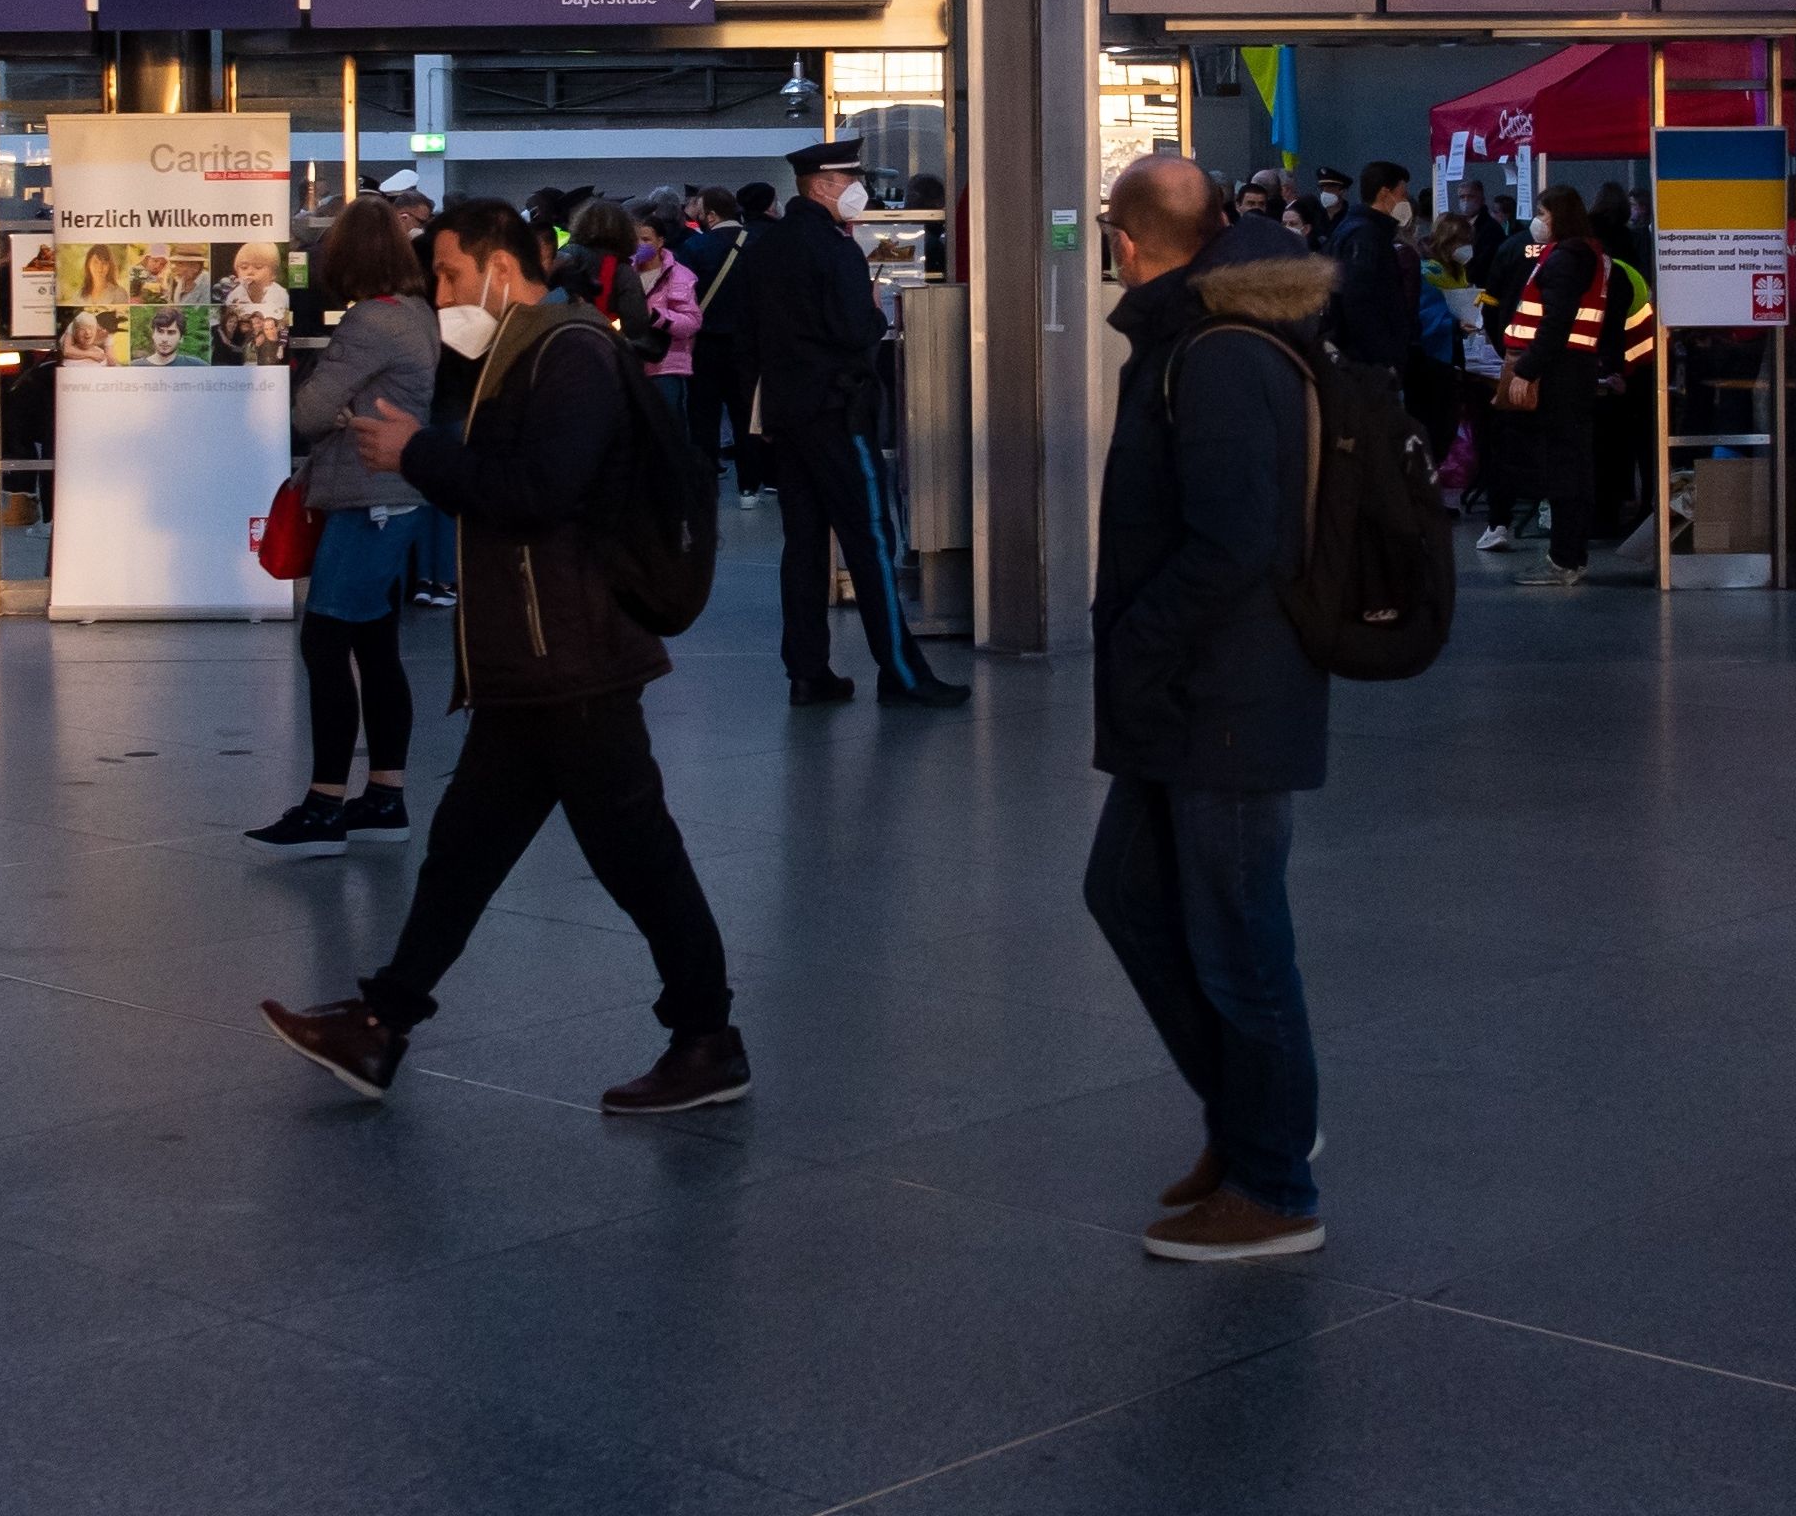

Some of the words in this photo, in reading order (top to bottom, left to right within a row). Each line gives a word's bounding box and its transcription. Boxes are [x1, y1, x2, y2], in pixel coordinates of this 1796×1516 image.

[150, 143, 274, 174] Caritas
[60, 209, 141, 229] Herzlich
[148, 209, 274, 228] Willkommen
[1658, 248, 1715, 256] Information
[1718, 248, 1735, 256] and
[1738, 248, 1759, 257] help
[1659, 263, 1715, 271] Information
[1738, 263, 1761, 271] Hilfe
